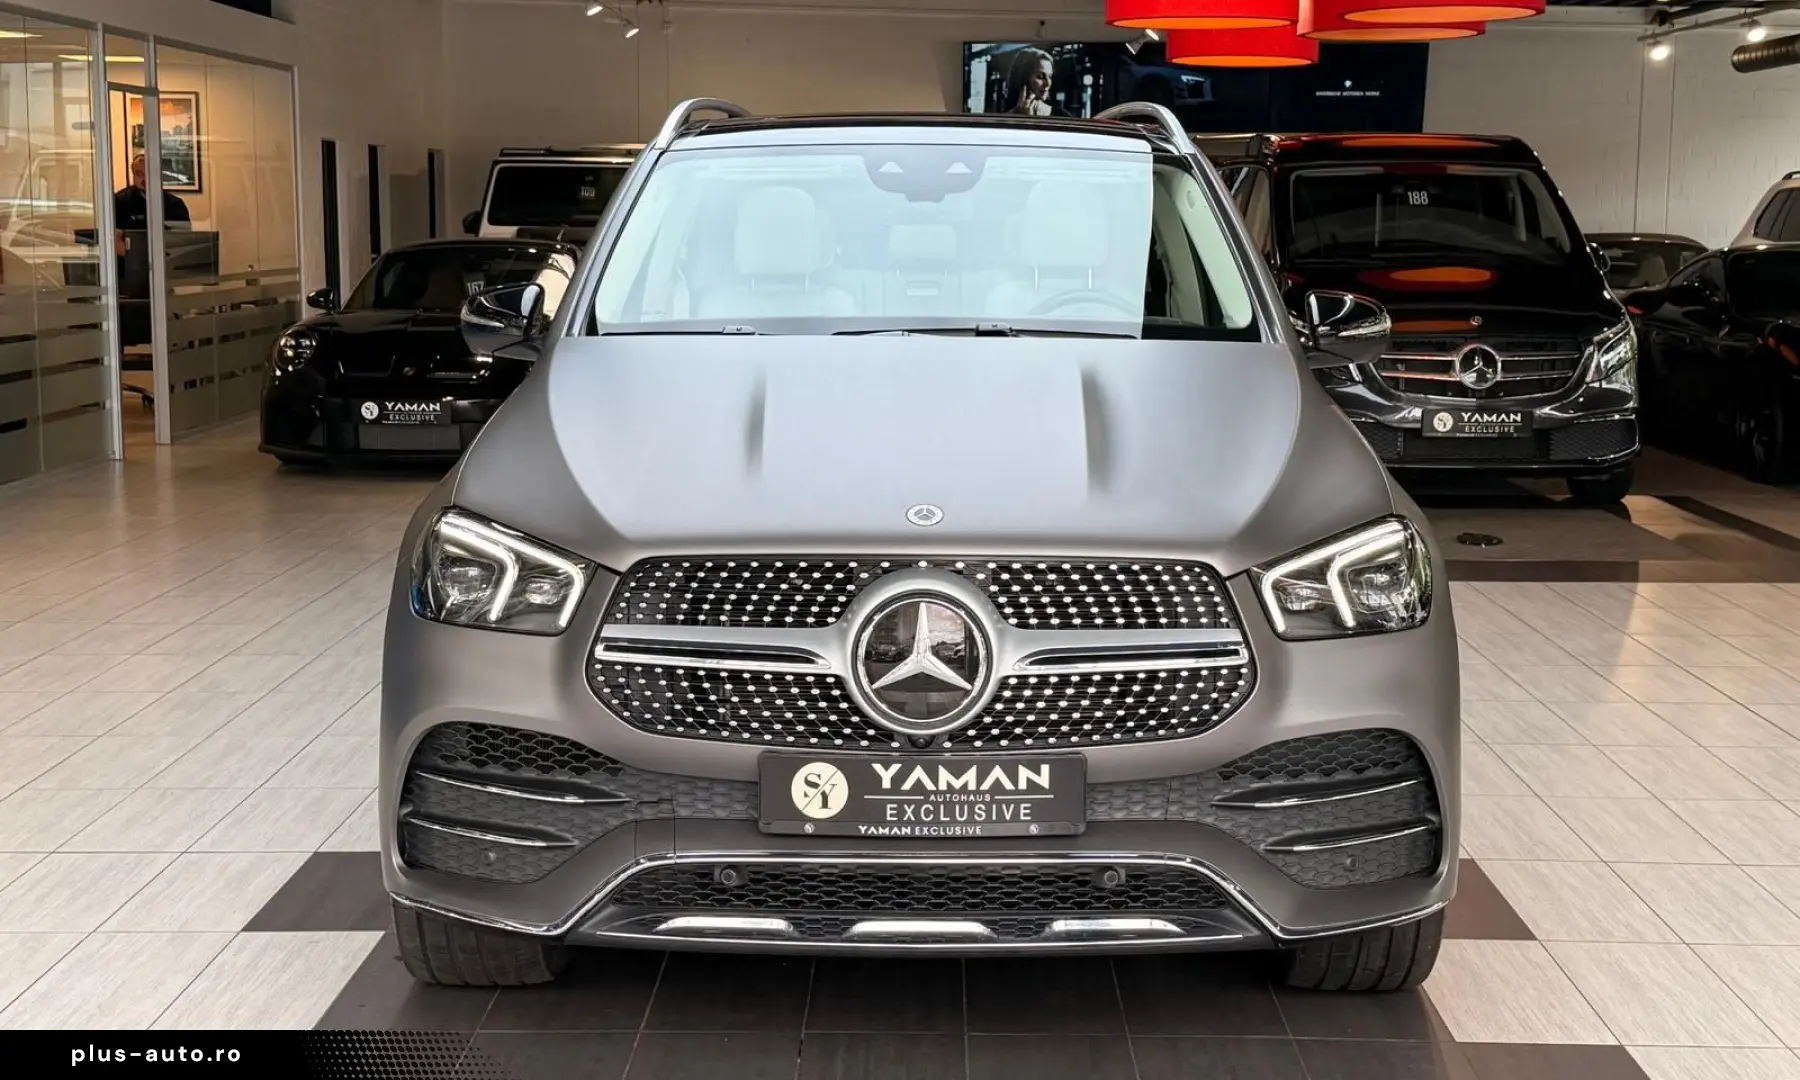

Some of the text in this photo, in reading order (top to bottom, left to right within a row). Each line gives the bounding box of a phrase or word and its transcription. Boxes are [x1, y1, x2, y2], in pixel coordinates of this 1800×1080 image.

[1407, 190, 1429, 205] 188
[385, 402, 441, 411] YAMAN
[1461, 412, 1522, 422] YAMAN
[1465, 425, 1515, 433] EXCLUSIVE
[872, 763, 1050, 790] YAMAN
[929, 794, 991, 802] AUTOHAUS
[886, 803, 1032, 821] EXCLUSIVE
[858, 825, 982, 835] YAMAN EXCLUSIVE
